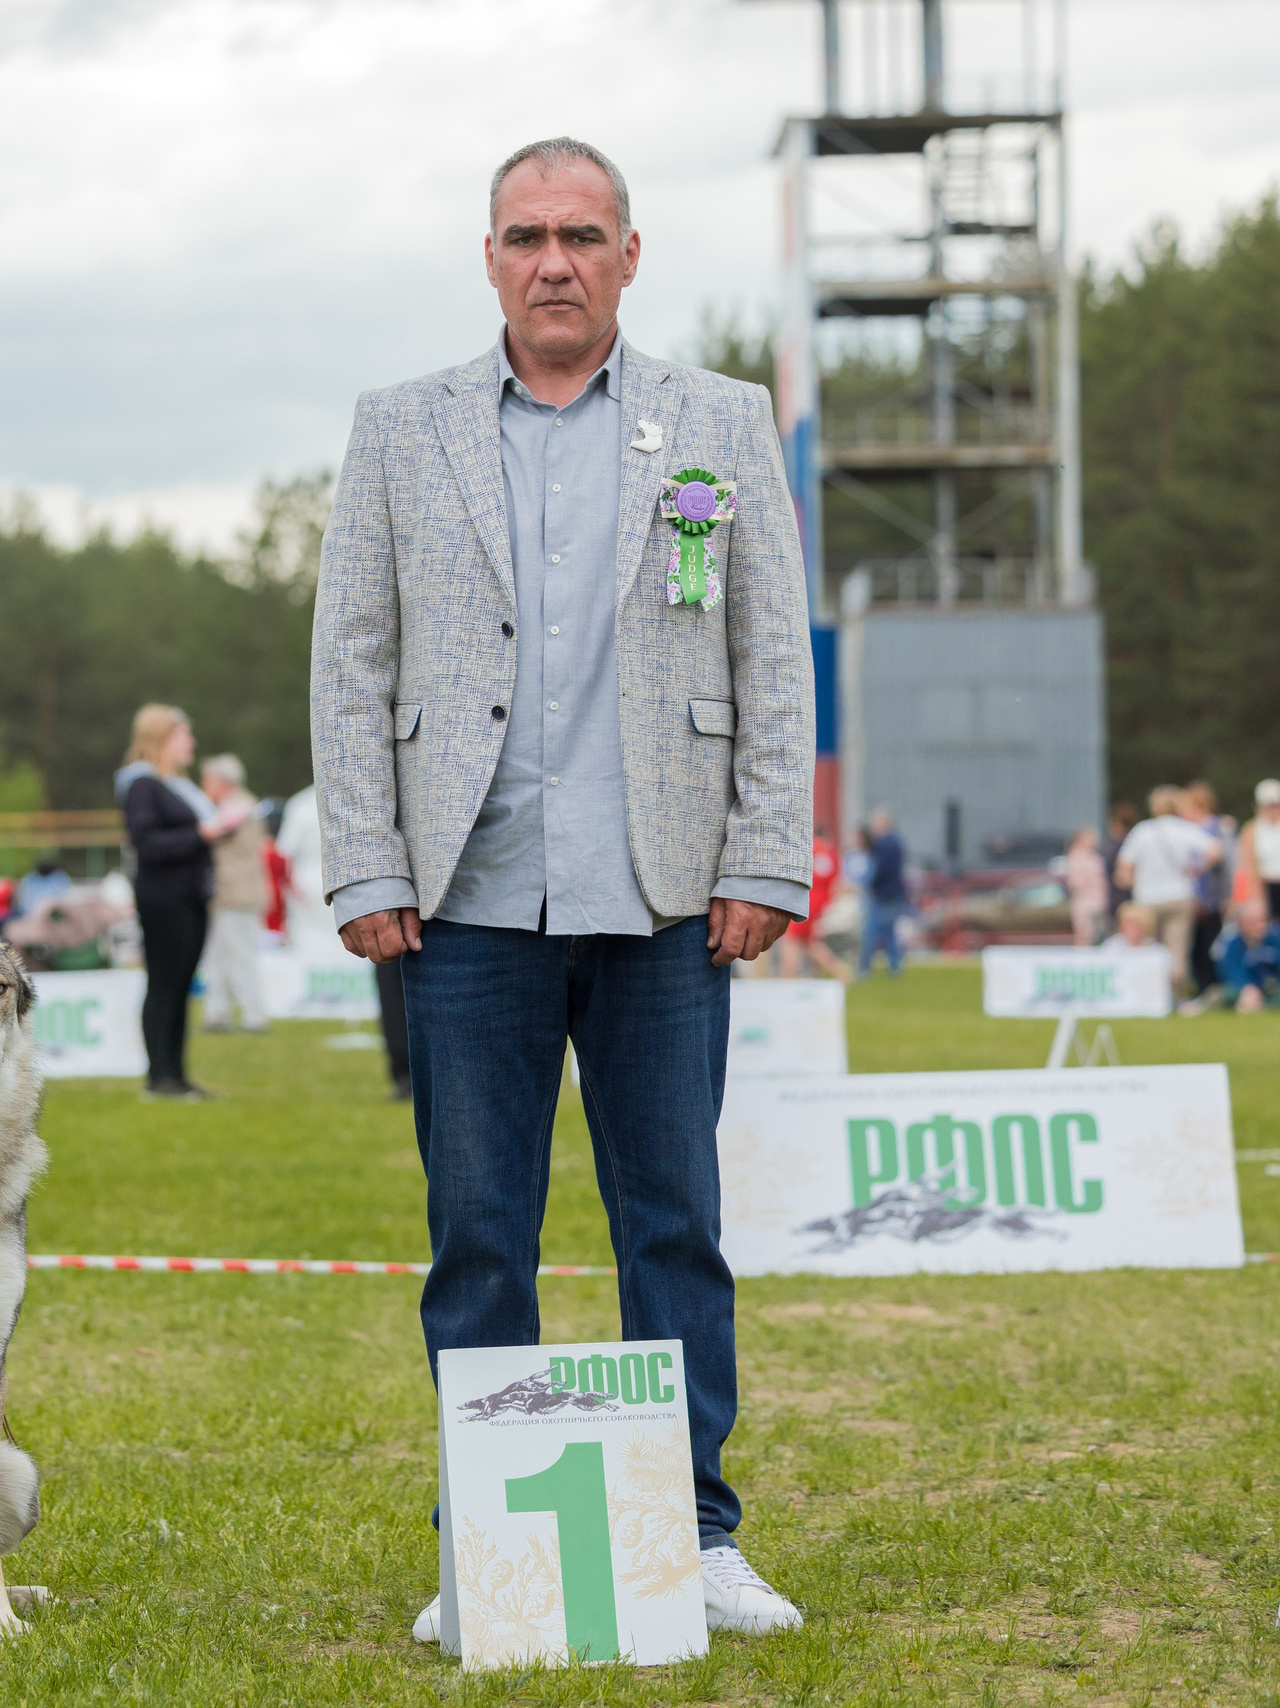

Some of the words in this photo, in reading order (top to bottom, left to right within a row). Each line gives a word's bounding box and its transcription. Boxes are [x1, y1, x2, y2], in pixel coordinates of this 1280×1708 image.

[687, 545, 698, 591] JUDGE
[548, 1352, 675, 1405] РФОС
[488, 1419, 540, 1428] ФЕДЕРАЦИЯ
[541, 1416, 604, 1425] ОХОТНИЧЬЕГО
[605, 1412, 678, 1422] СОБАКОВОДСТВА
[504, 1441, 620, 1662] 1
